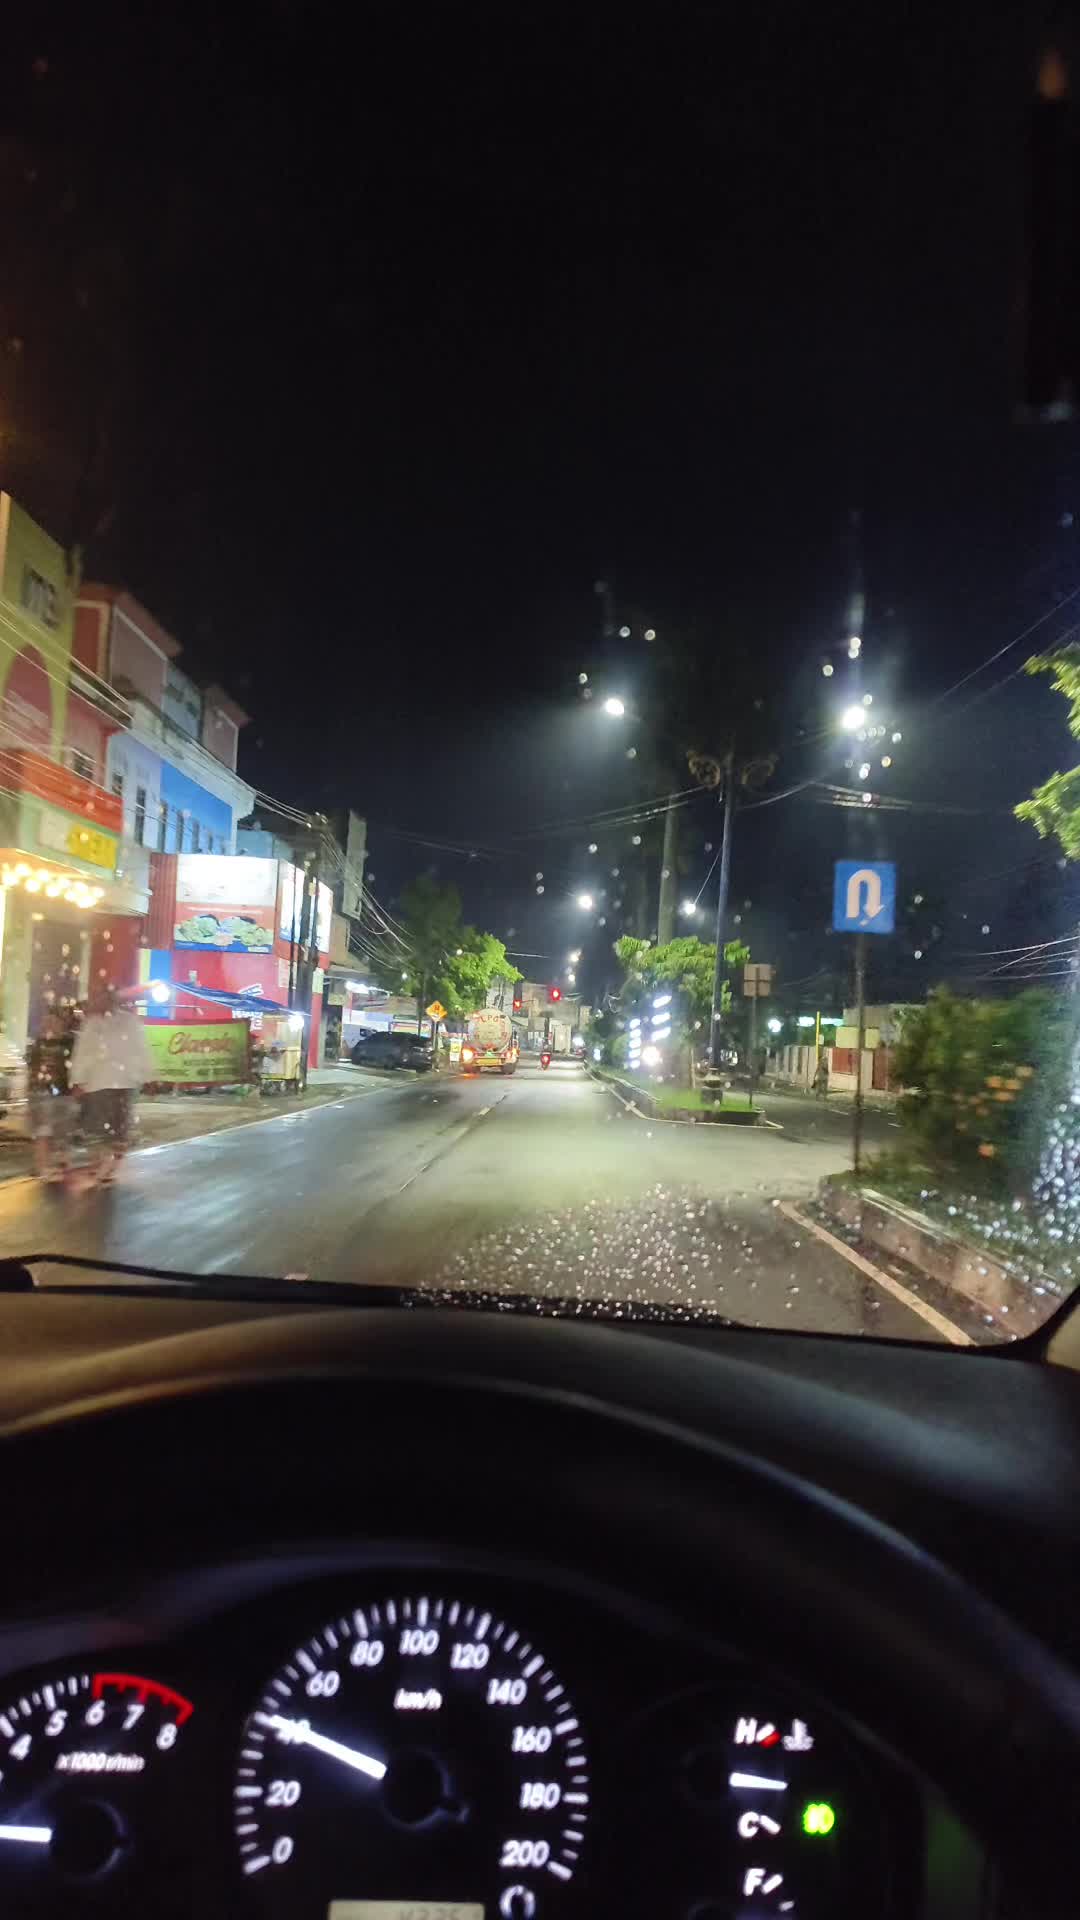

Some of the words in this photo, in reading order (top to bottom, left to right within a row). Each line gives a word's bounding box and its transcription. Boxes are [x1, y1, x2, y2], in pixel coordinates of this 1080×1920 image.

[350, 1639, 385, 1667] 80
[399, 1628, 440, 1656] 100
[450, 1642, 490, 1671] 120
[305, 1667, 340, 1697] 60
[487, 1678, 528, 1706] 140
[85, 1699, 105, 1726] 6
[394, 1687, 443, 1711] km/h
[45, 1709, 68, 1737] 5
[122, 1703, 145, 1731] 7
[734, 1717, 759, 1744] H
[9, 1734, 33, 1761] 4
[156, 1722, 178, 1750] 8
[511, 1725, 553, 1753] 160
[265, 1779, 301, 1807] 20
[519, 1782, 561, 1810] 180
[737, 1810, 760, 1838] C
[272, 1836, 294, 1864] 0
[500, 1839, 550, 1869] 200
[743, 1867, 766, 1897] F
